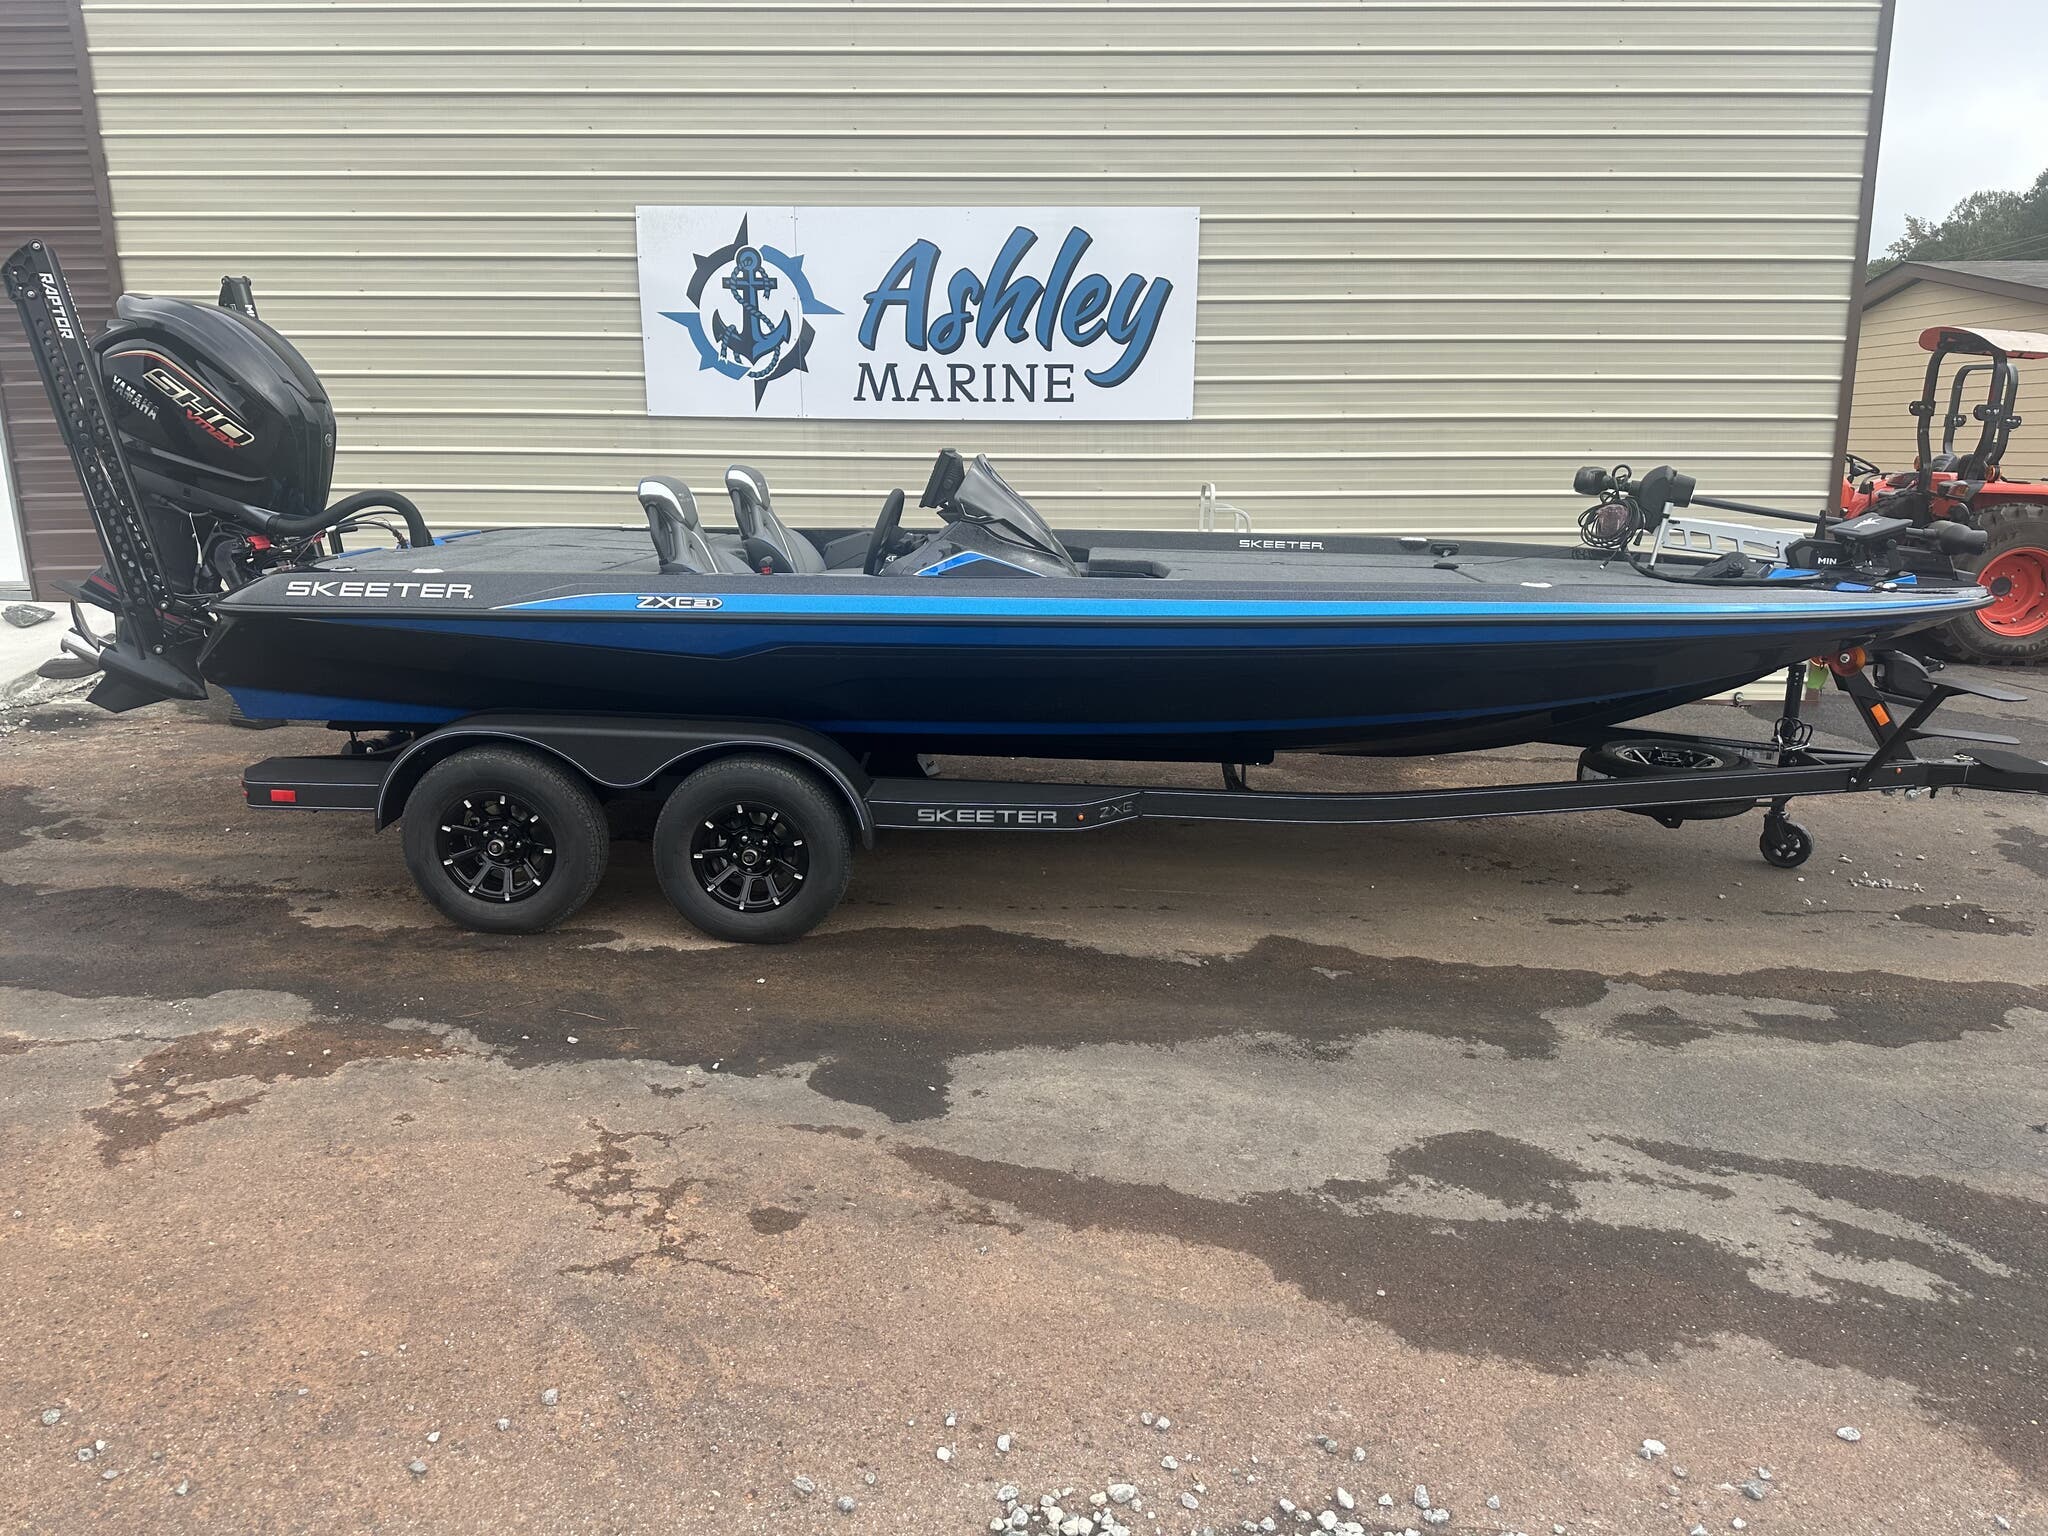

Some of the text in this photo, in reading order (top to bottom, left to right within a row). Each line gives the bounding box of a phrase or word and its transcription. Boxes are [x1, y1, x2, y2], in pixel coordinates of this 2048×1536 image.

[38, 272, 75, 339] RAPTOR
[858, 226, 1173, 388] Ashley
[111, 375, 159, 420] YAMAHA
[853, 363, 1075, 402] MARINE
[142, 368, 255, 446] SHO
[1239, 539, 1325, 550] SKEETER
[286, 581, 475, 599] SKEETER
[917, 808, 1058, 824] SKEETER
[1099, 801, 1133, 819] ZXE
